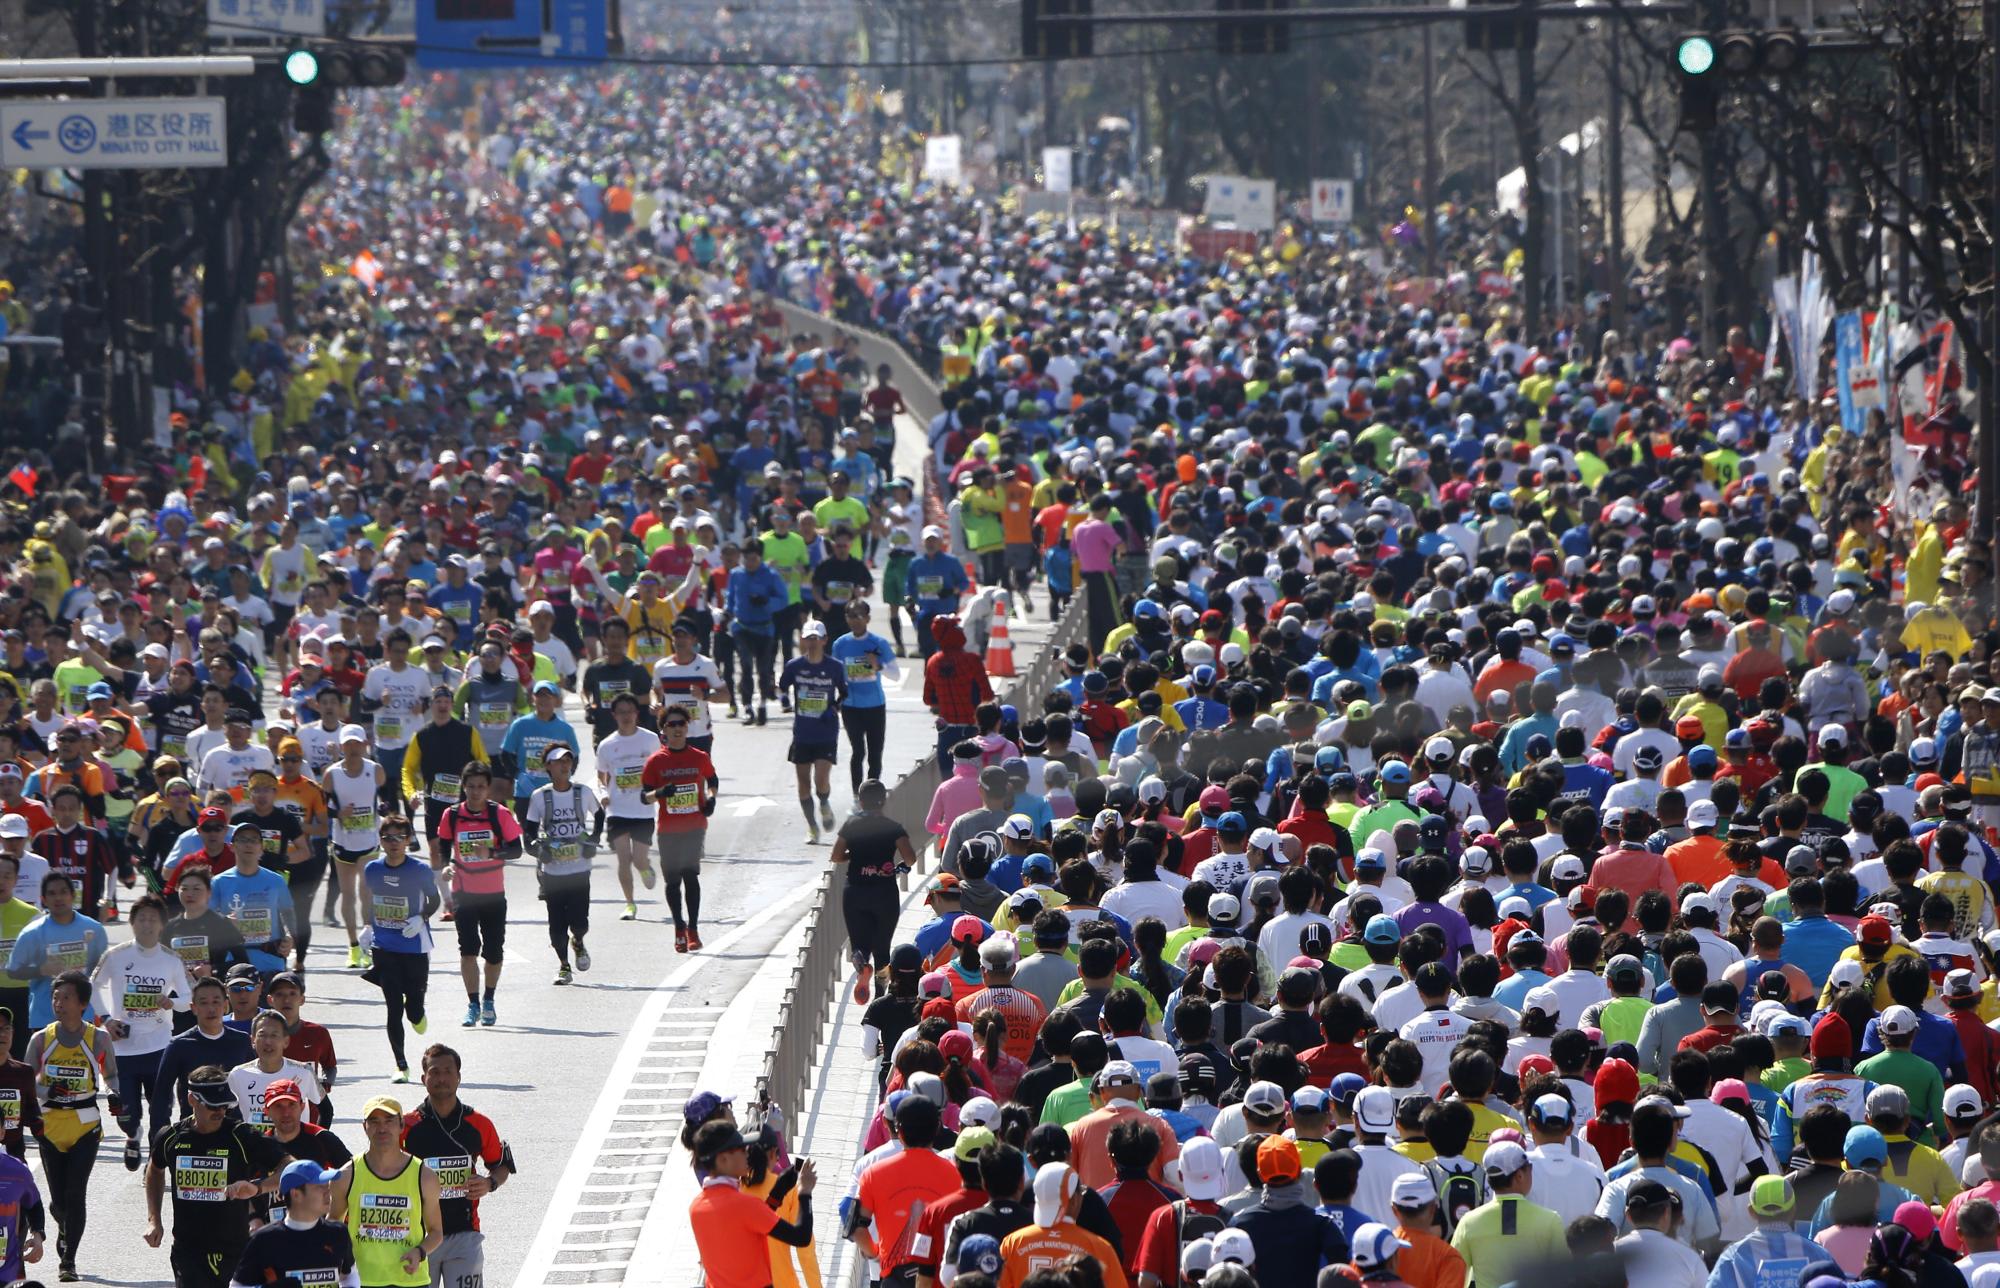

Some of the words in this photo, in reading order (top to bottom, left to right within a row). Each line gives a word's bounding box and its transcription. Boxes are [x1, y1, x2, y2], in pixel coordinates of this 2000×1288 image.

[107, 112, 212, 138] 港区役所
[100, 141, 149, 153] MINATO
[155, 141, 182, 153] CITY
[188, 140, 220, 152] HALL
[661, 768, 699, 777] UNDER
[125, 974, 166, 986] TOKYO
[1008, 1028, 1031, 1040] 016
[177, 1171, 219, 1187] B80316
[436, 1169, 466, 1186] 5005
[361, 1208, 403, 1225] B23066
